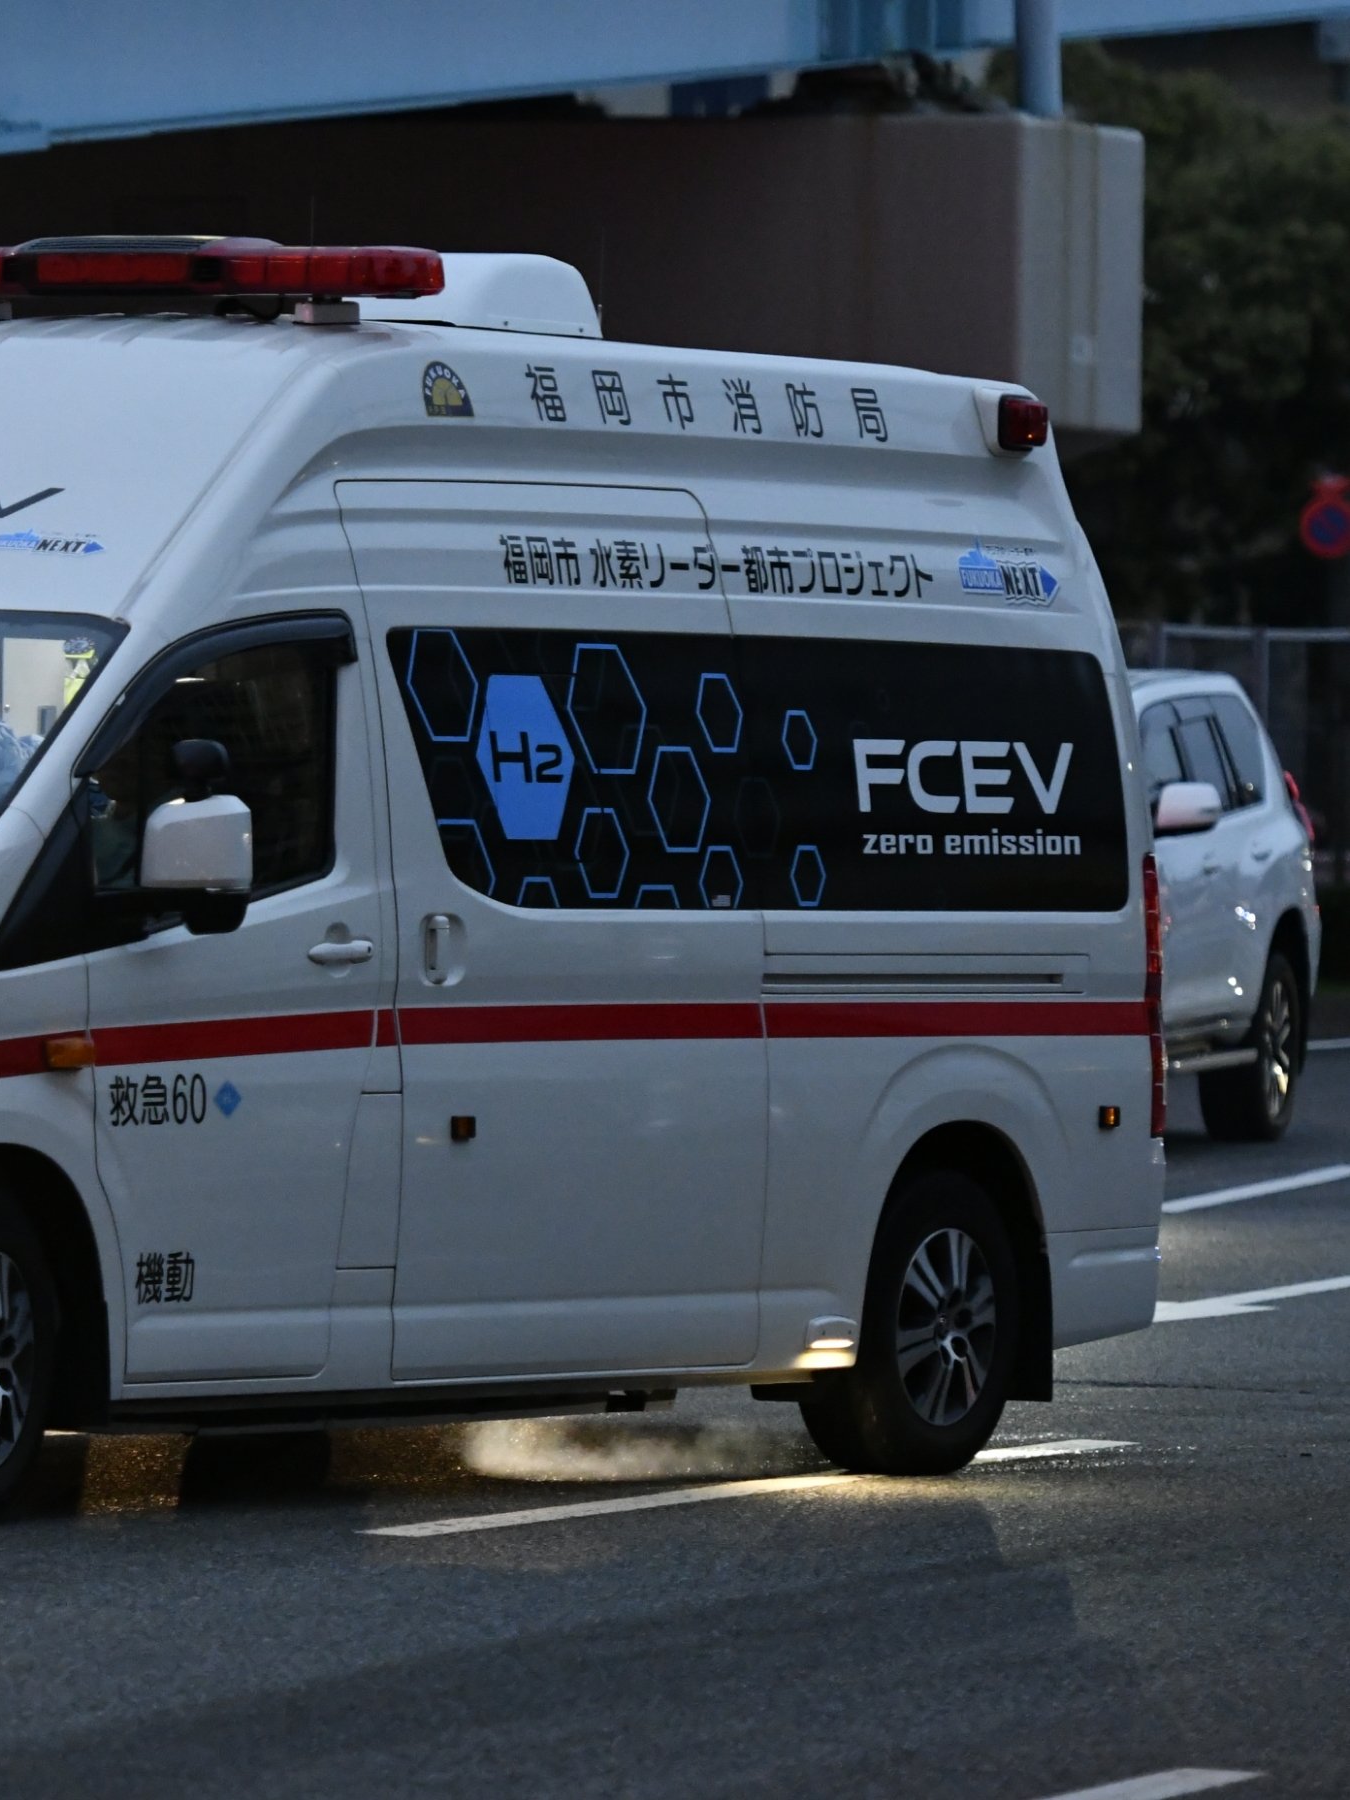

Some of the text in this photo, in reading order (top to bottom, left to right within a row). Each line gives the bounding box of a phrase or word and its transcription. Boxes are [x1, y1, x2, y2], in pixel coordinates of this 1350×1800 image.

[525, 363, 889, 443] 福岡市消防局
[36, 539, 87, 553] NEXT
[499, 534, 934, 599] 福岡市 水素リーダー都市プロジェクト
[1000, 564, 1041, 598] NEXT
[853, 738, 1074, 815] FCEV
[861, 829, 1082, 856] zero emission
[109, 1073, 207, 1127] 救急60
[135, 1251, 196, 1305] 機動
